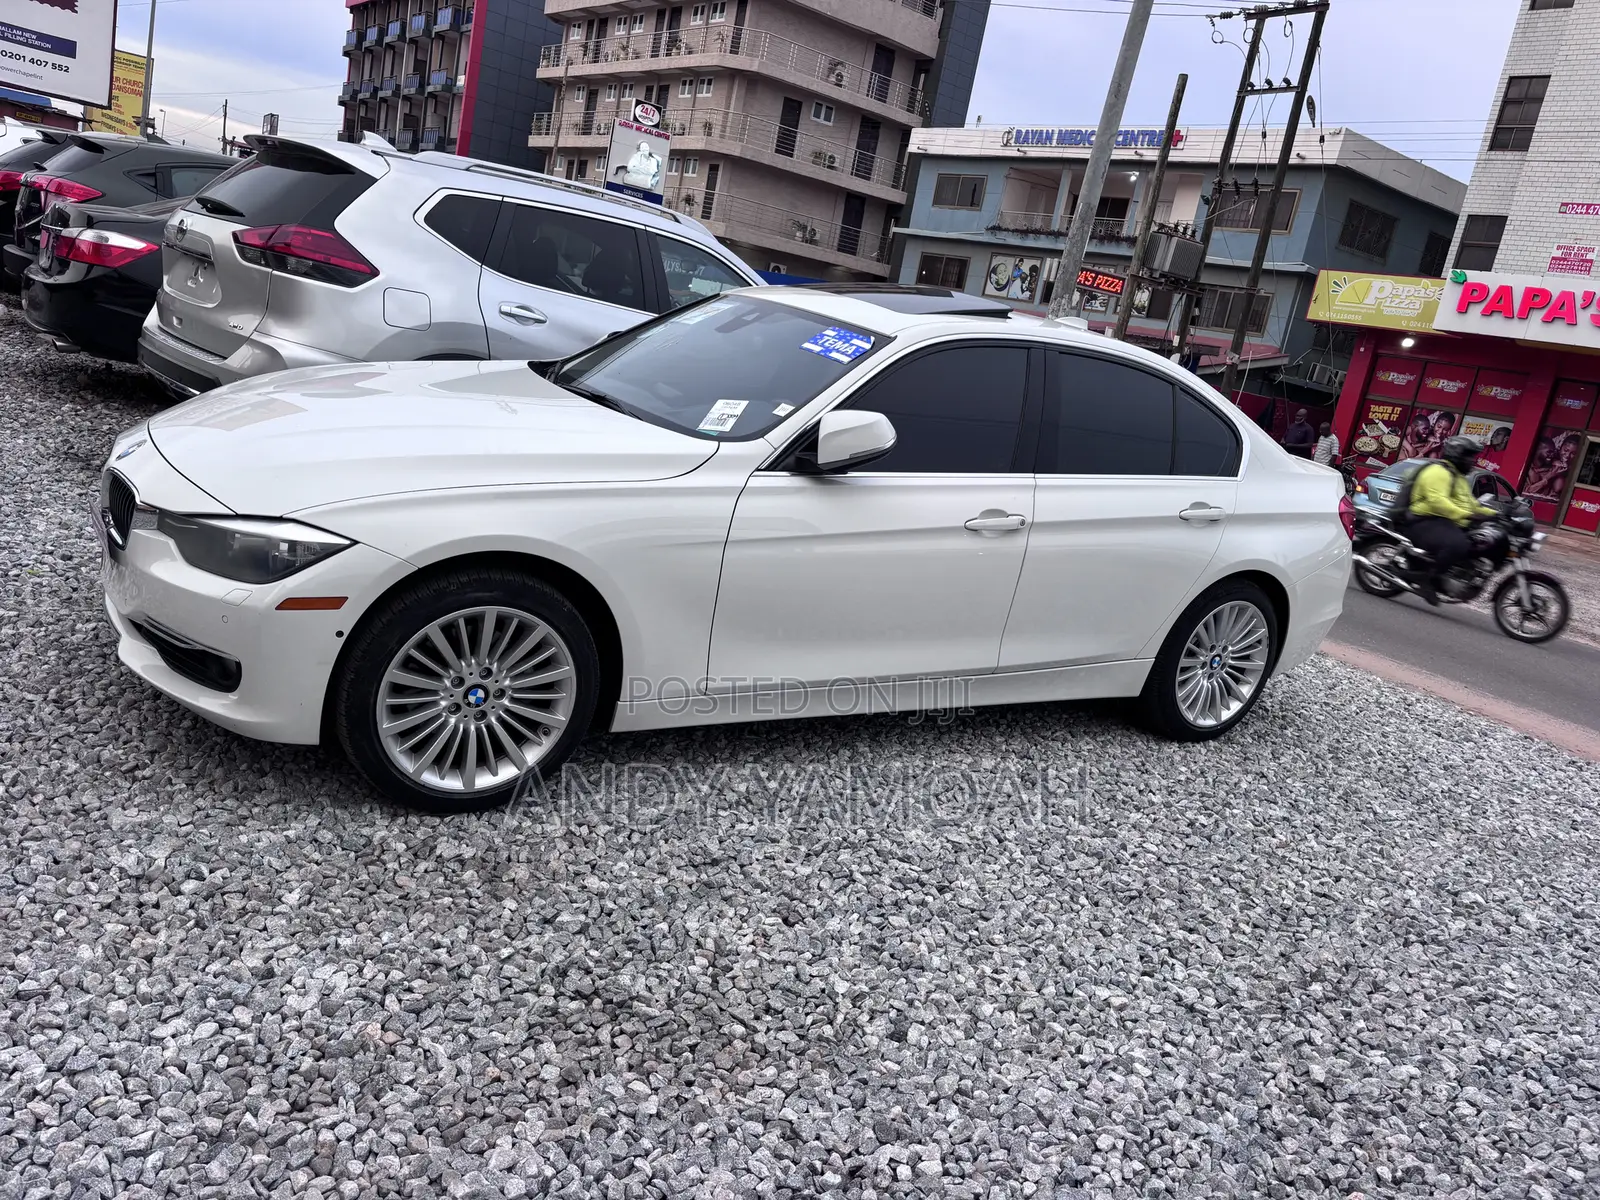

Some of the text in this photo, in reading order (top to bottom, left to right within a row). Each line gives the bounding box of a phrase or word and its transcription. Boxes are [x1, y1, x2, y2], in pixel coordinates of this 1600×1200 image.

[4, 32, 27, 42] FILLING
[27, 38, 52, 49] STATION
[22, 32, 37, 40] NEW
[0, 50, 70, 73] 0201 407 552
[0, 66, 43, 80] owerchapelint
[640, 104, 656, 118] 24/7
[1014, 129, 1055, 145] RAYAN
[1056, 129, 1097, 147] MEDIC
[1114, 129, 1166, 147] CENTRE
[1566, 204, 1587, 214] 0244
[1576, 245, 1596, 253] SPACE
[1077, 270, 1123, 293] A'S PIZZA
[817, 335, 857, 355] TEMA
[1370, 404, 1403, 414] TASTE IT
[1368, 411, 1399, 422] LOVE IT
